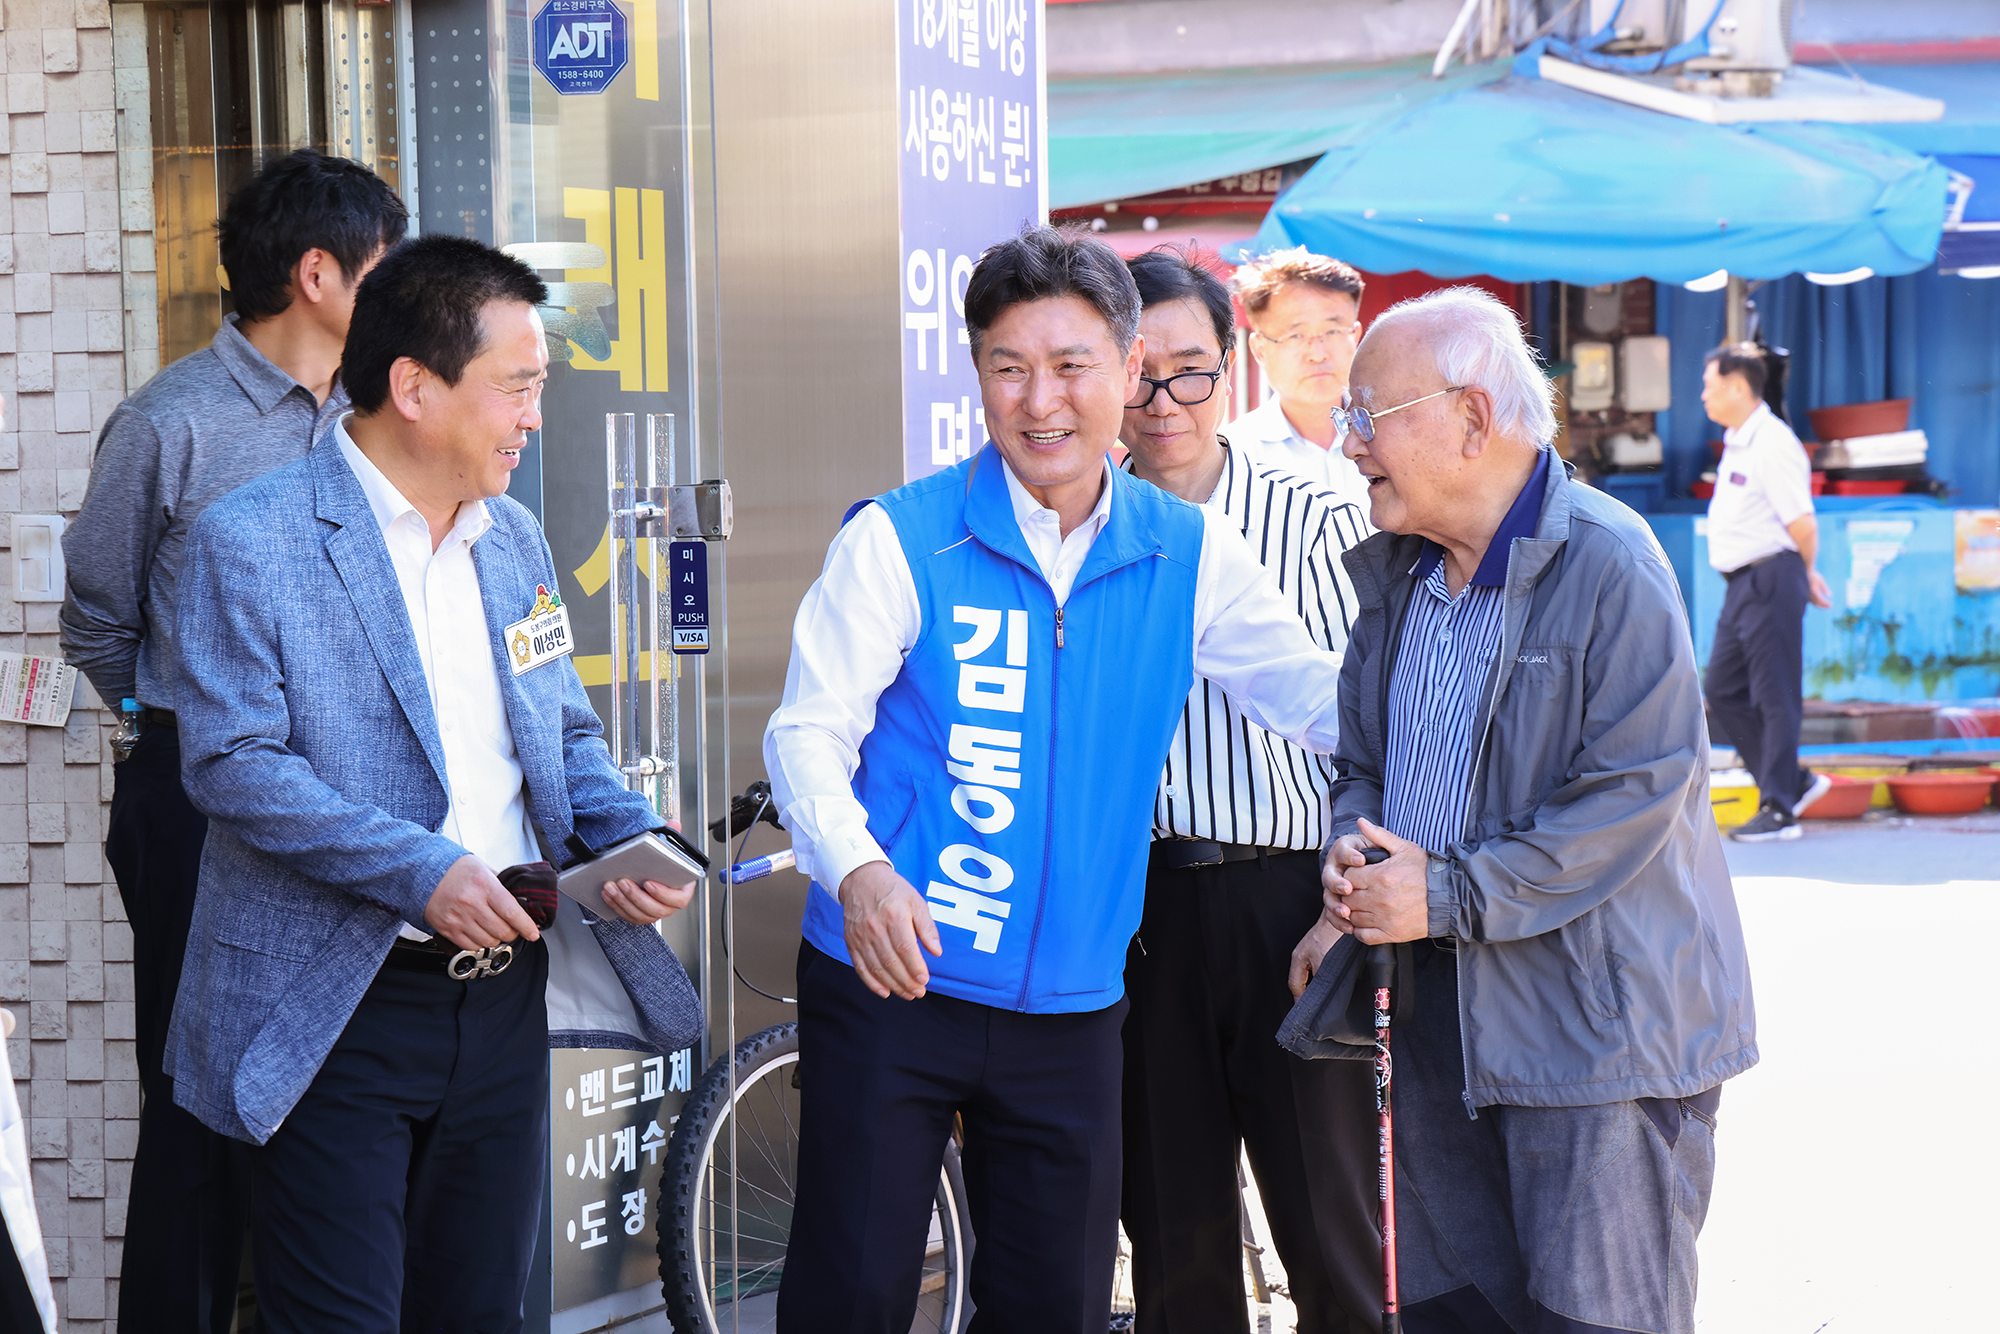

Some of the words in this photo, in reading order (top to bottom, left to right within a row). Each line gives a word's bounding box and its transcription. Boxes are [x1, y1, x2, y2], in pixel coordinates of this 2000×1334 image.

[548, 22, 612, 59] ADT
[986, 0, 1027, 77] 이상
[558, 70, 604, 79] 1588-6400
[905, 85, 996, 183] 사용하신
[678, 612, 704, 623] PUSH
[678, 632, 704, 643] VISA
[533, 625, 567, 656] 이성민
[51, 661, 65, 703] 1833-2827
[926, 605, 1028, 954] 김동욱
[580, 1048, 692, 1117] 밴드교체
[579, 1115, 680, 1180] 시계수
